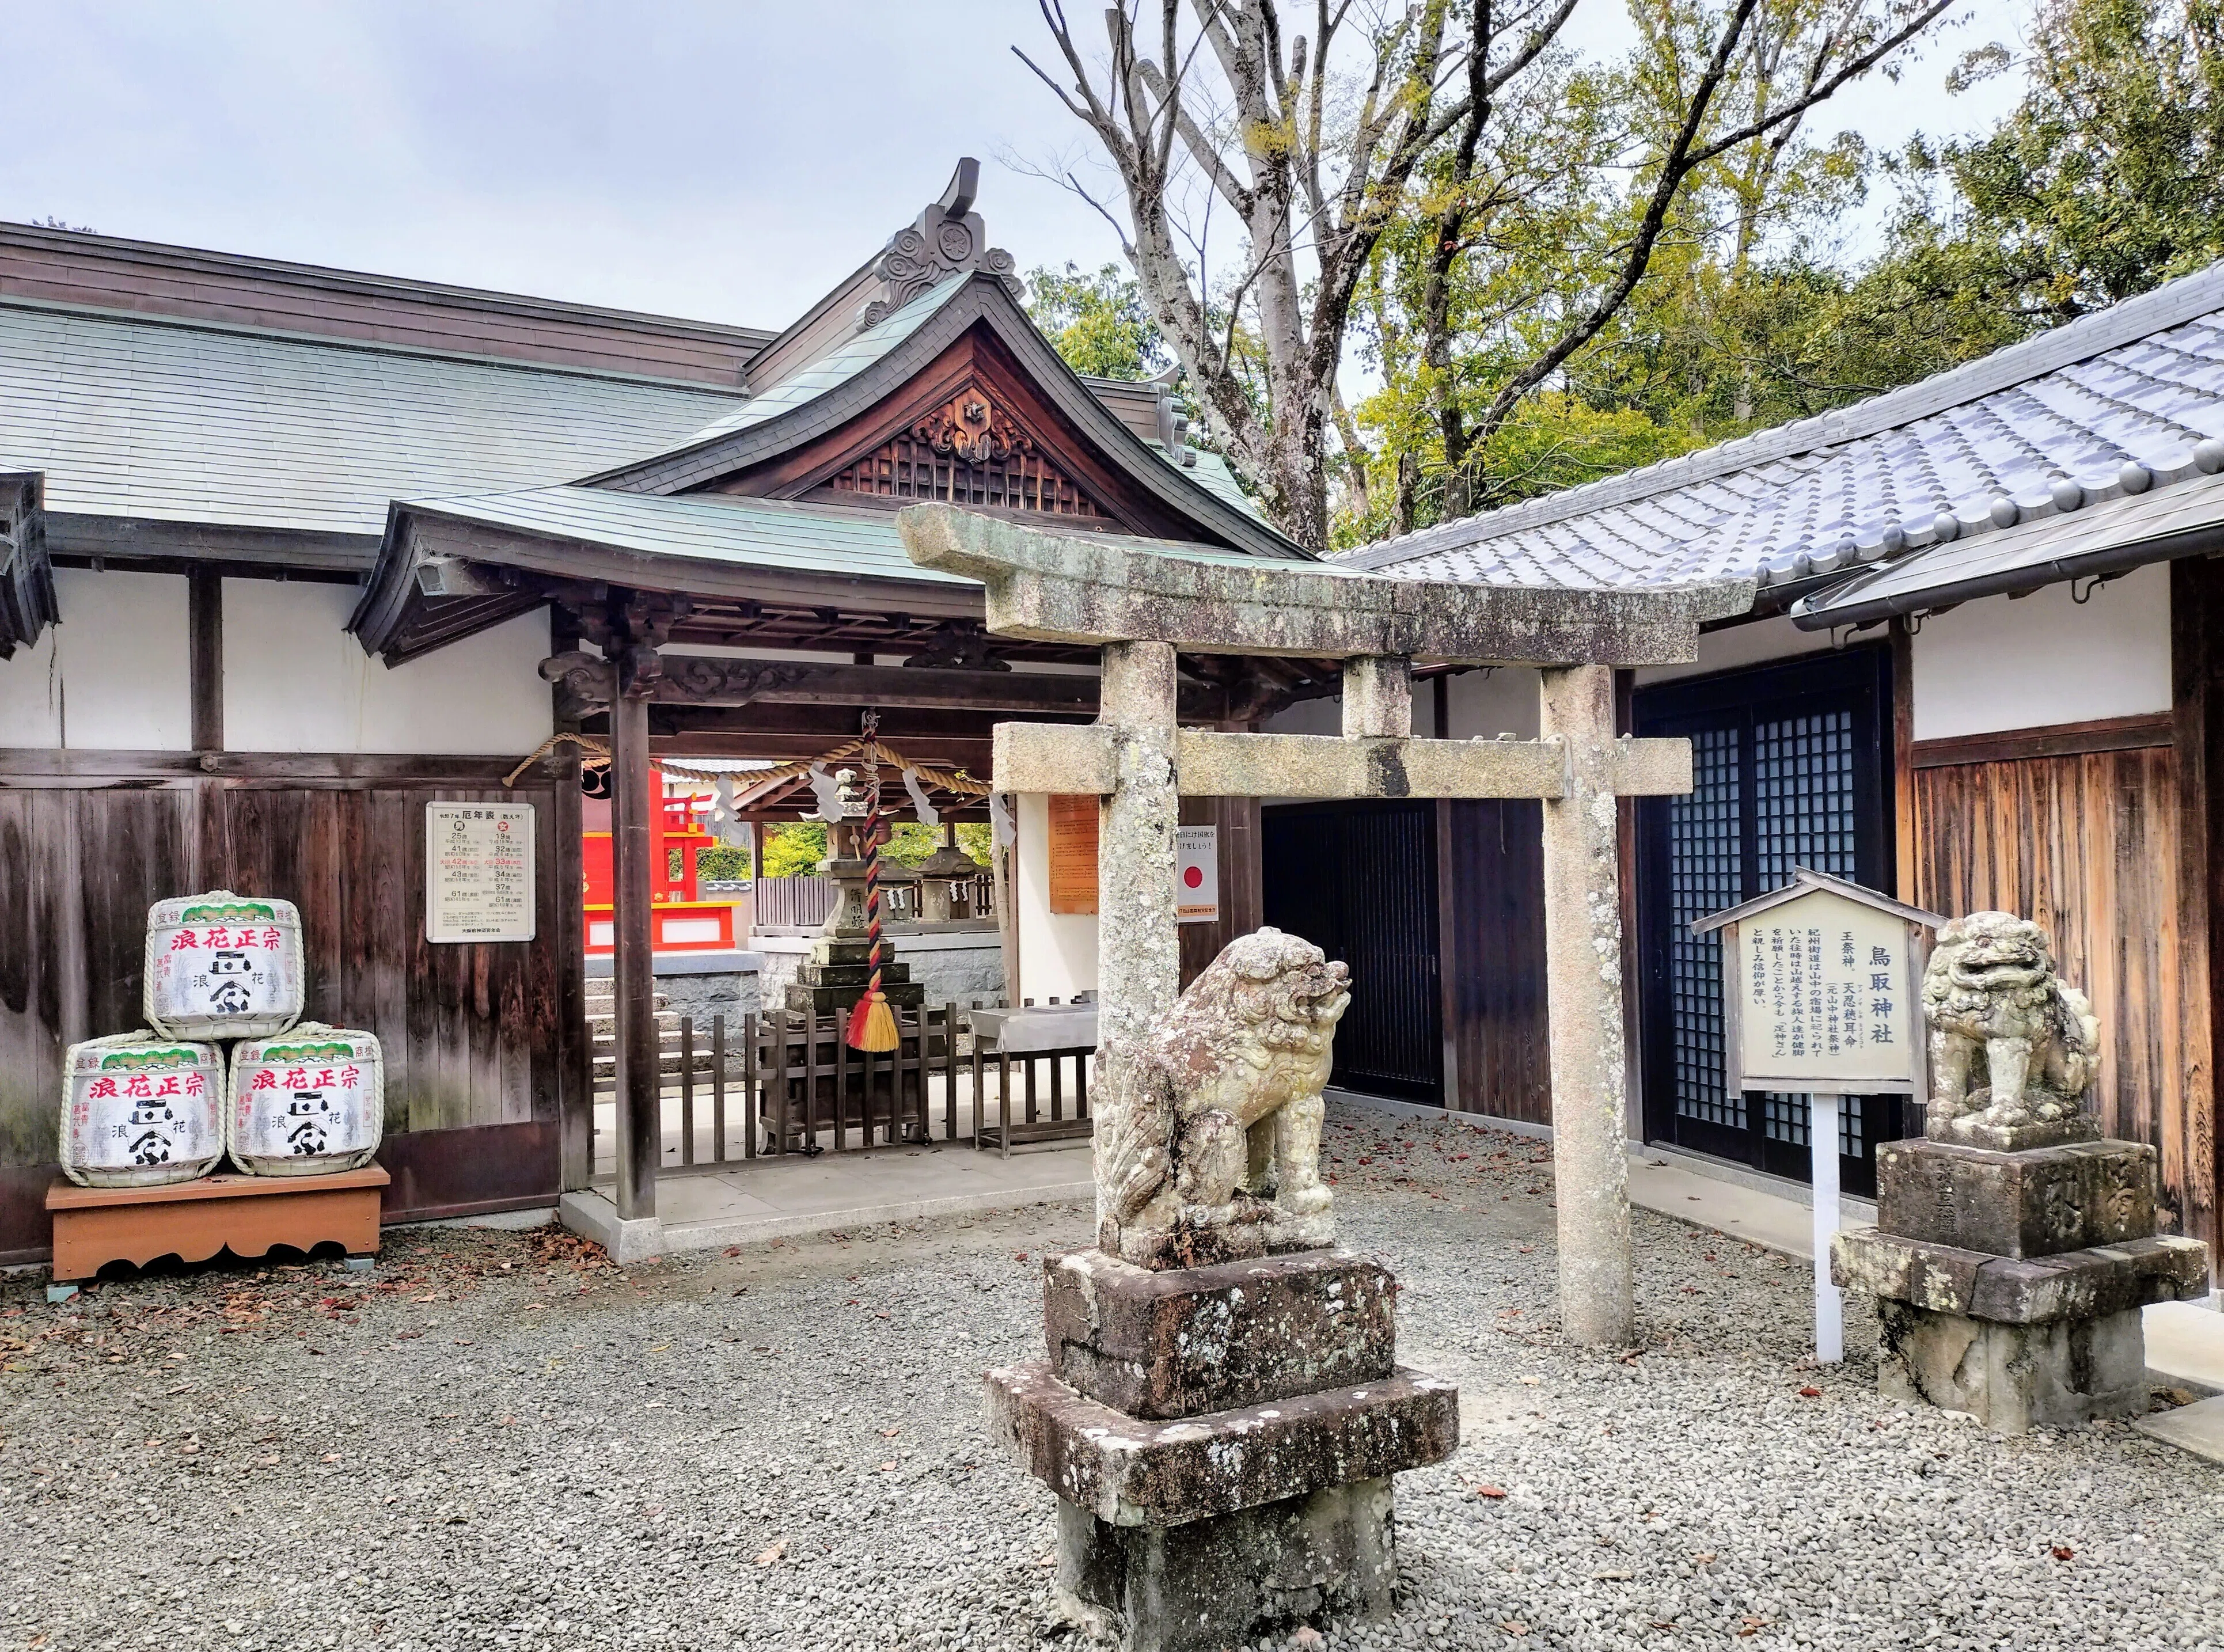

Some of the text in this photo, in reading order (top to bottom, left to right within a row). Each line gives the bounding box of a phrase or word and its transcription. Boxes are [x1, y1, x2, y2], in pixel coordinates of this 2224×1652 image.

[170, 925, 281, 951] 浪花正宗
[193, 971, 264, 988] 浪 花
[1751, 928, 1766, 1008] と親しみ信仰が厚い。
[1808, 928, 1823, 1058] 紀州街道は山中の宿場に祀られて
[1869, 945, 1895, 1044] 鳥取神社
[89, 1070, 206, 1099] 浪花正宗
[252, 1064, 360, 1091] 浪花正宗
[111, 1121, 186, 1138] 浪 花
[271, 1112, 341, 1129] 浪 花
